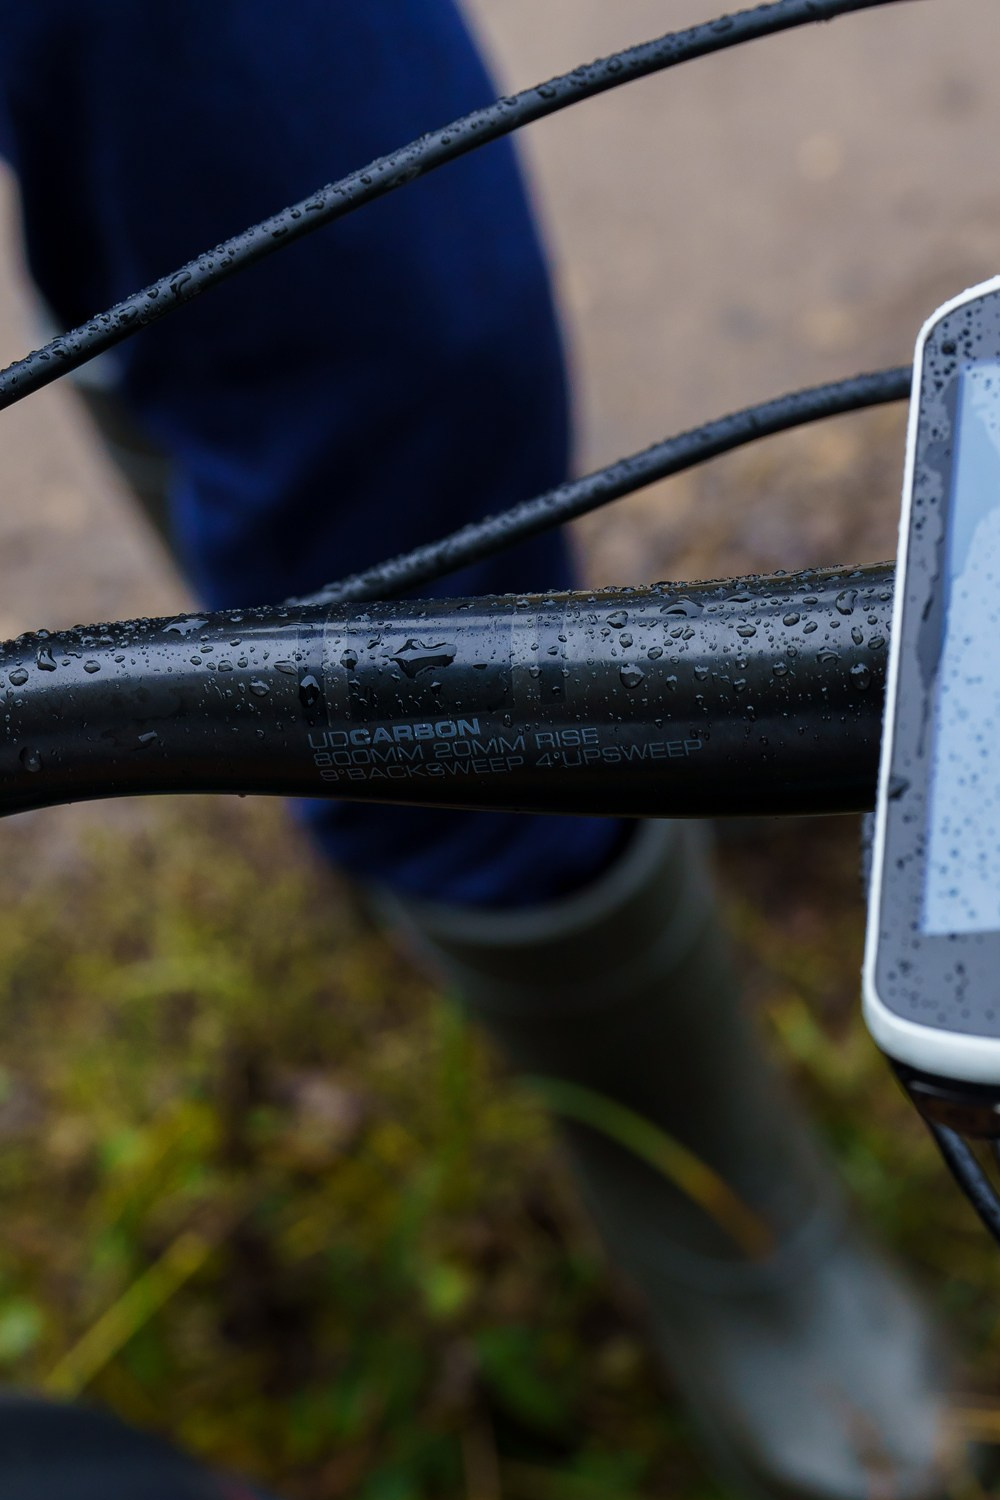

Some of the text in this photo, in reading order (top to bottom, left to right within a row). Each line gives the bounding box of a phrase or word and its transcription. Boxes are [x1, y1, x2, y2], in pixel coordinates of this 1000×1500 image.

[312, 727, 599, 768] 800MM 20MM RISE
